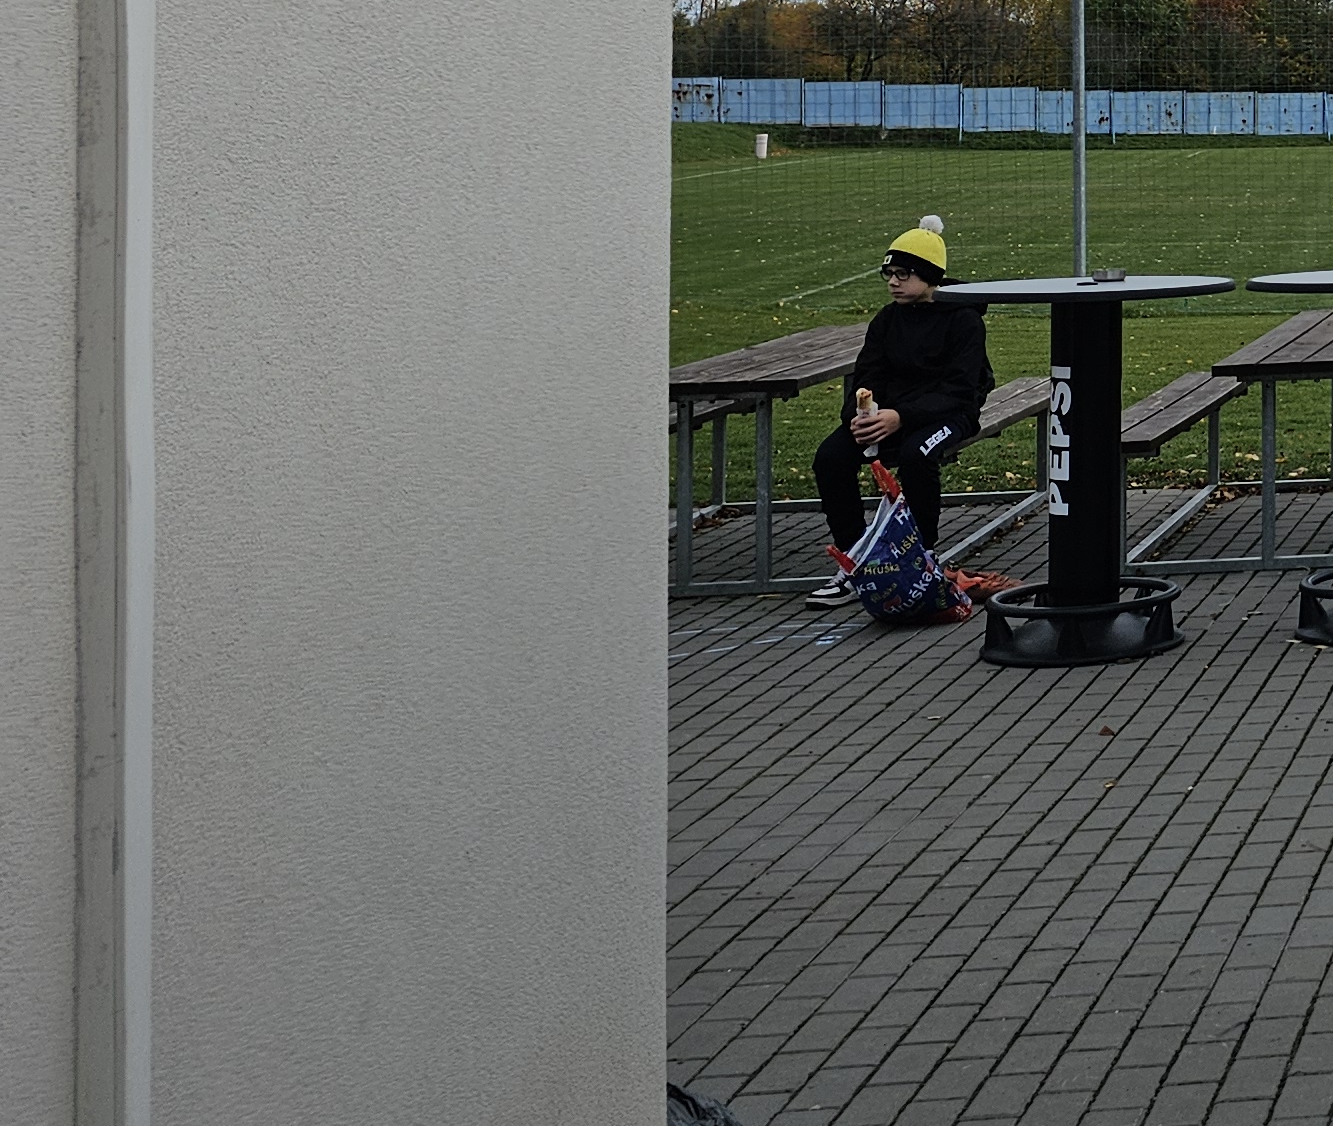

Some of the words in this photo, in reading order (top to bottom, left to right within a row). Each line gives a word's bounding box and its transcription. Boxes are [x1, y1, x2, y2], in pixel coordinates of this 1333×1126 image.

[919, 425, 952, 456] LEGEA
[1049, 365, 1072, 516] PEPSI
[883, 571, 933, 613] Hruška
